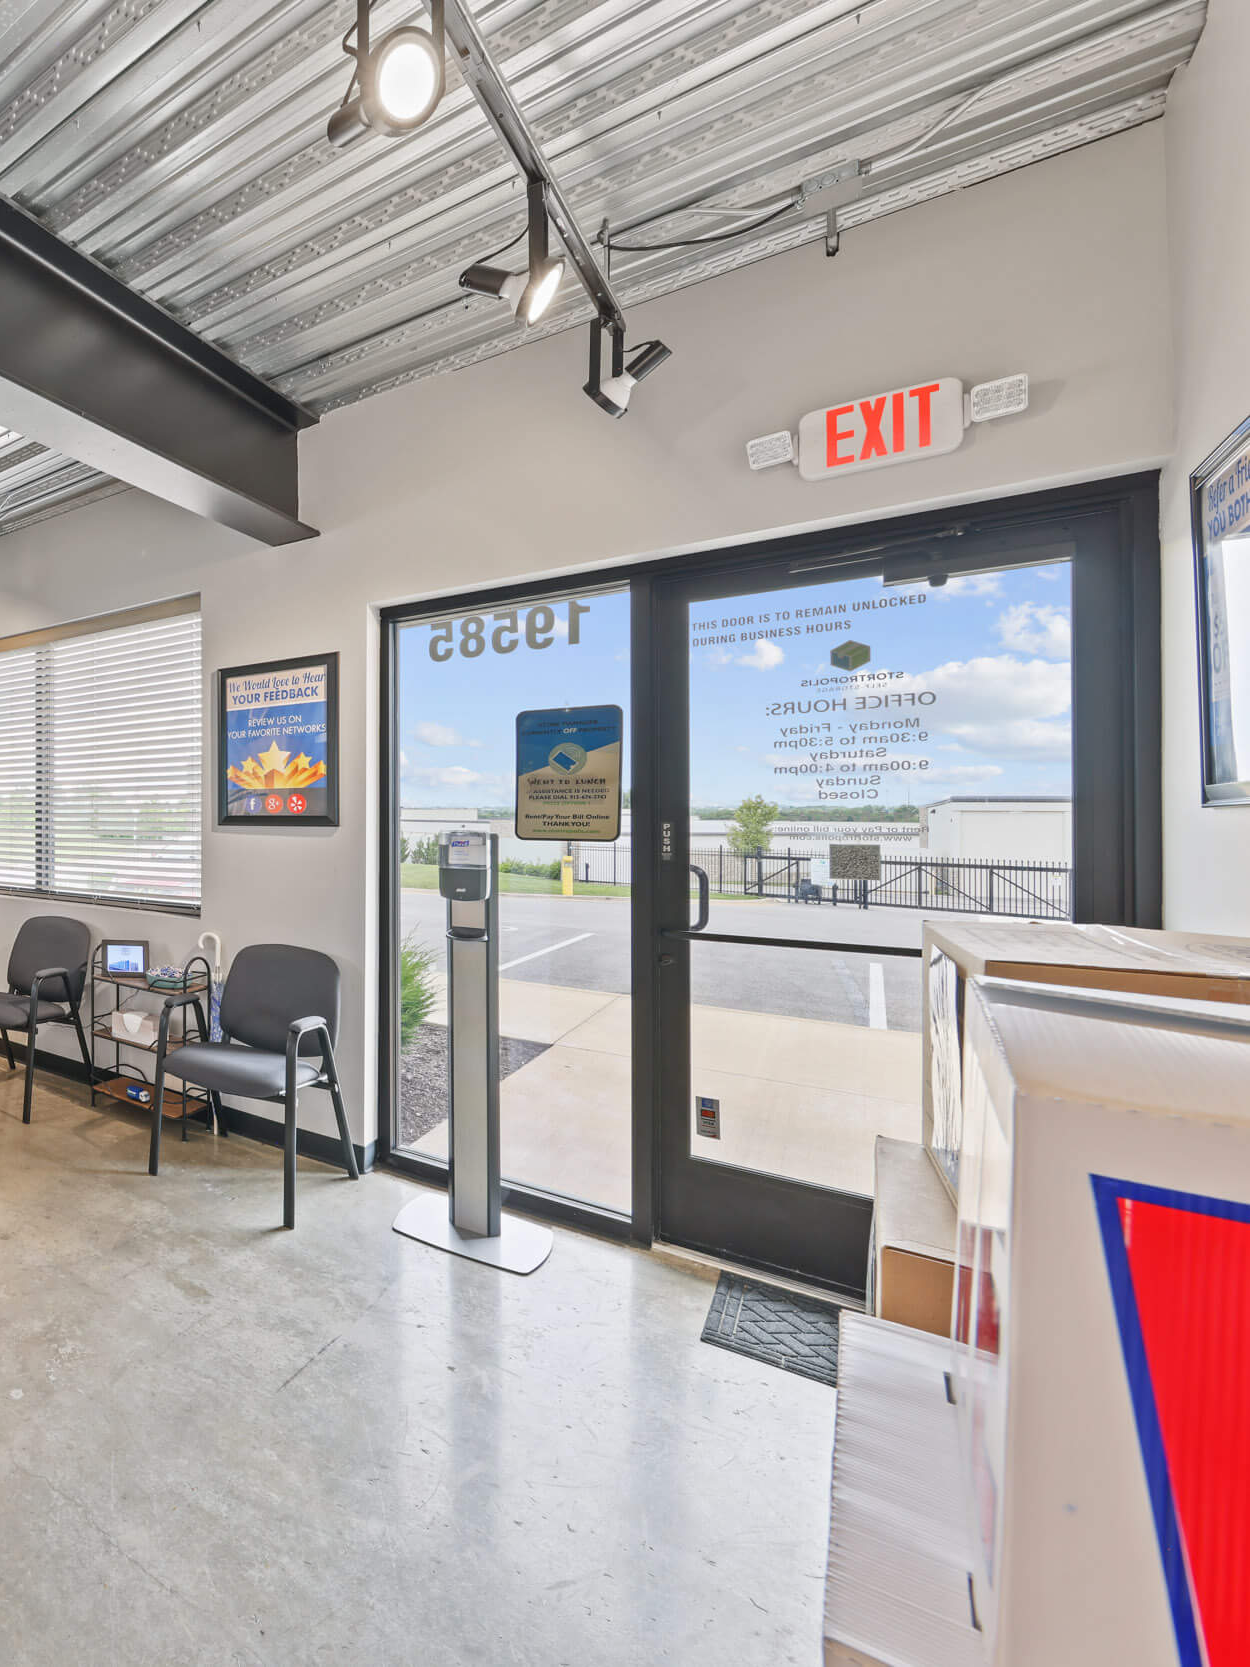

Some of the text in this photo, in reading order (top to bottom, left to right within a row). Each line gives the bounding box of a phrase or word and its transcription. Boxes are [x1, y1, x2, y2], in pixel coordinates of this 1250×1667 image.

[826, 383, 940, 468] EXIT
[1207, 510, 1226, 541] YOU
[692, 593, 927, 632] THIS DOOR IS TO REMAIN UNLOCKED
[692, 619, 852, 647] DURING BUSINESS HOURS
[229, 671, 326, 693] We Would Love to Hear
[232, 686, 319, 705] YOUR FEEDBACK
[228, 723, 326, 740] YOUR FAVORITE NETWORKS
[247, 715, 302, 728] REVIEW US ON
[662, 823, 671, 852] PUSH
